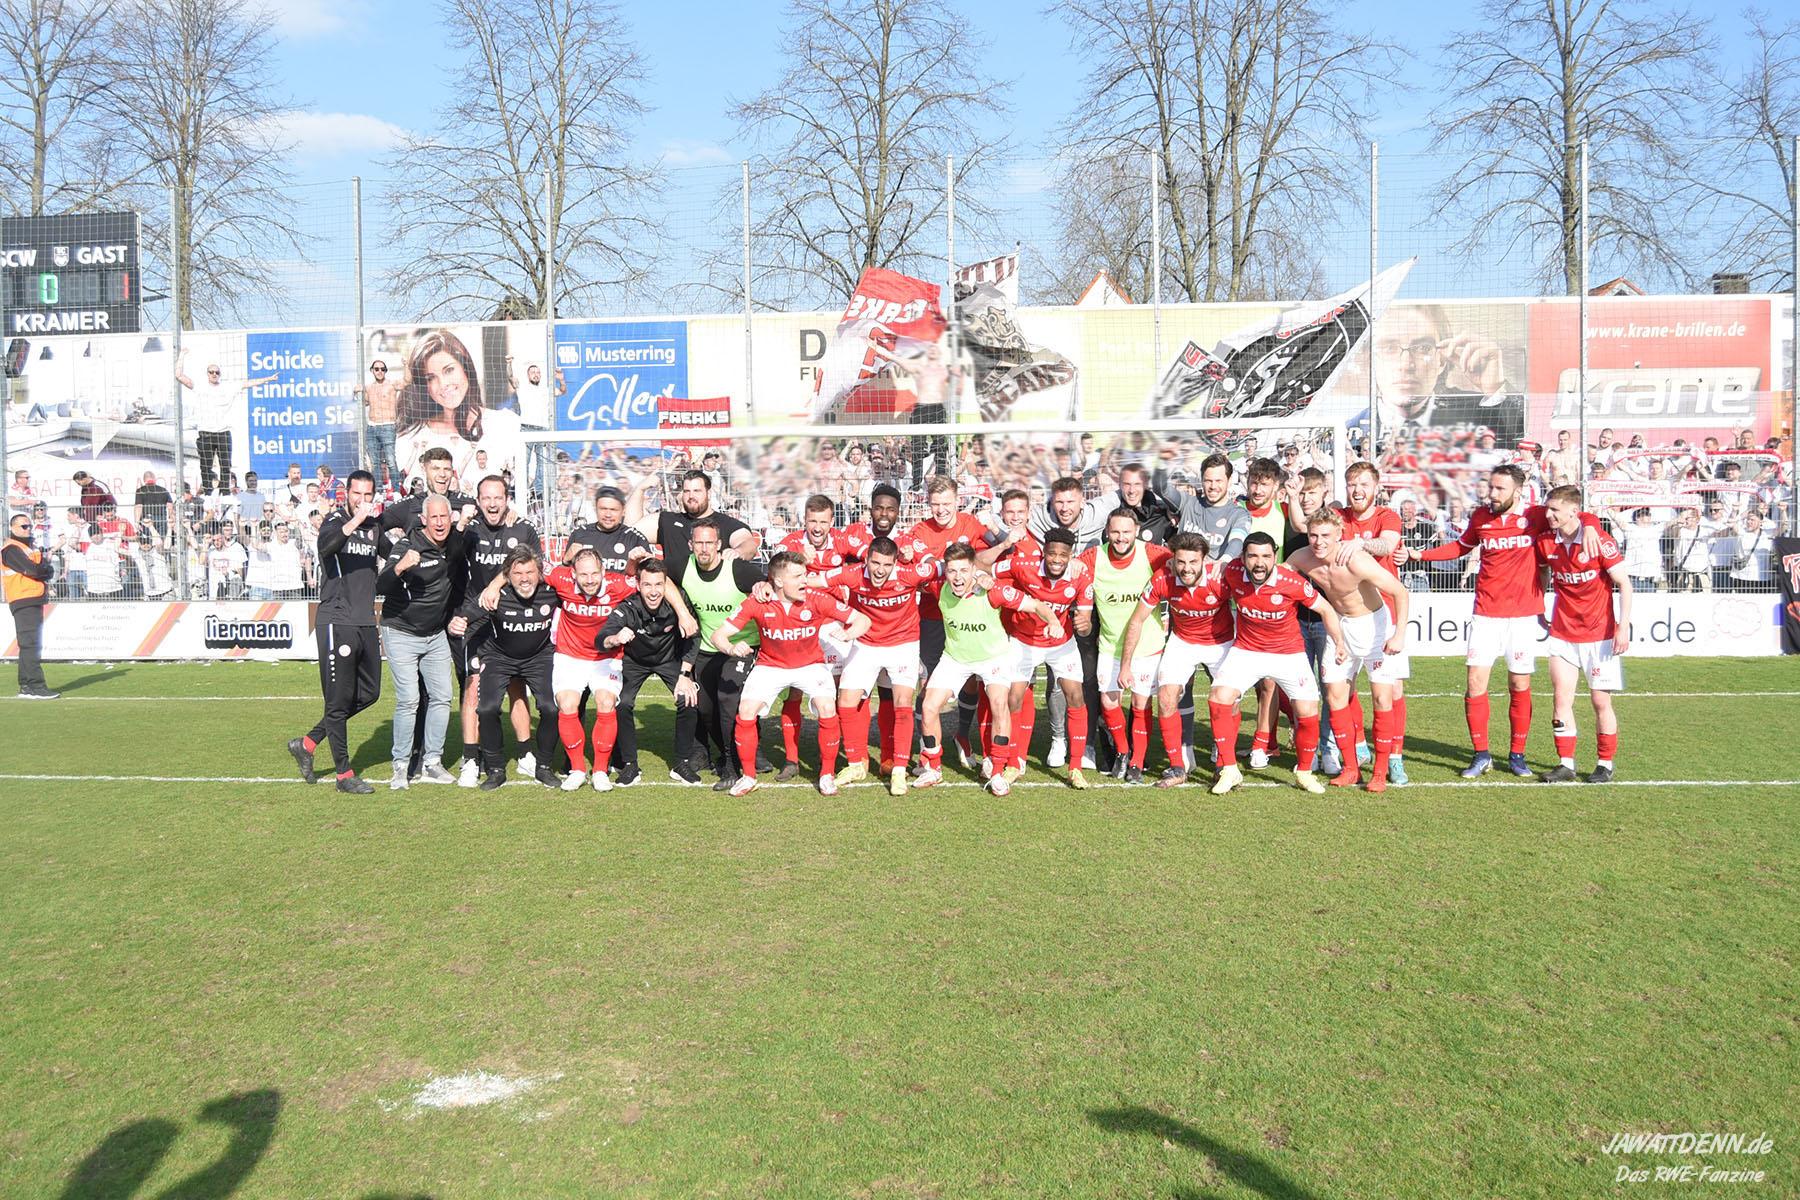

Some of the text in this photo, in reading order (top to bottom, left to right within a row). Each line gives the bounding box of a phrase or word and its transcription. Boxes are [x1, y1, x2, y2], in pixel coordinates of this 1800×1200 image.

[77, 245, 128, 265] GAST
[40, 273, 59, 309] 0
[15, 311, 111, 333] KRAMER
[1585, 321, 1746, 338] www.krane-brillen.de
[251, 350, 324, 371] Schicke
[585, 345, 676, 364] Musterring
[252, 378, 352, 398] Einrichtun
[1558, 373, 1753, 415] krane
[252, 404, 354, 427] finden Sie
[658, 410, 729, 425] FREAKS
[253, 434, 333, 456] bei uns!
[1480, 534, 1533, 550] HARFID
[857, 592, 912, 608] HARFID
[1120, 593, 1142, 603] JAK
[705, 604, 733, 613] JAKO
[762, 625, 817, 641] HARFID
[959, 622, 987, 633] JAKO
